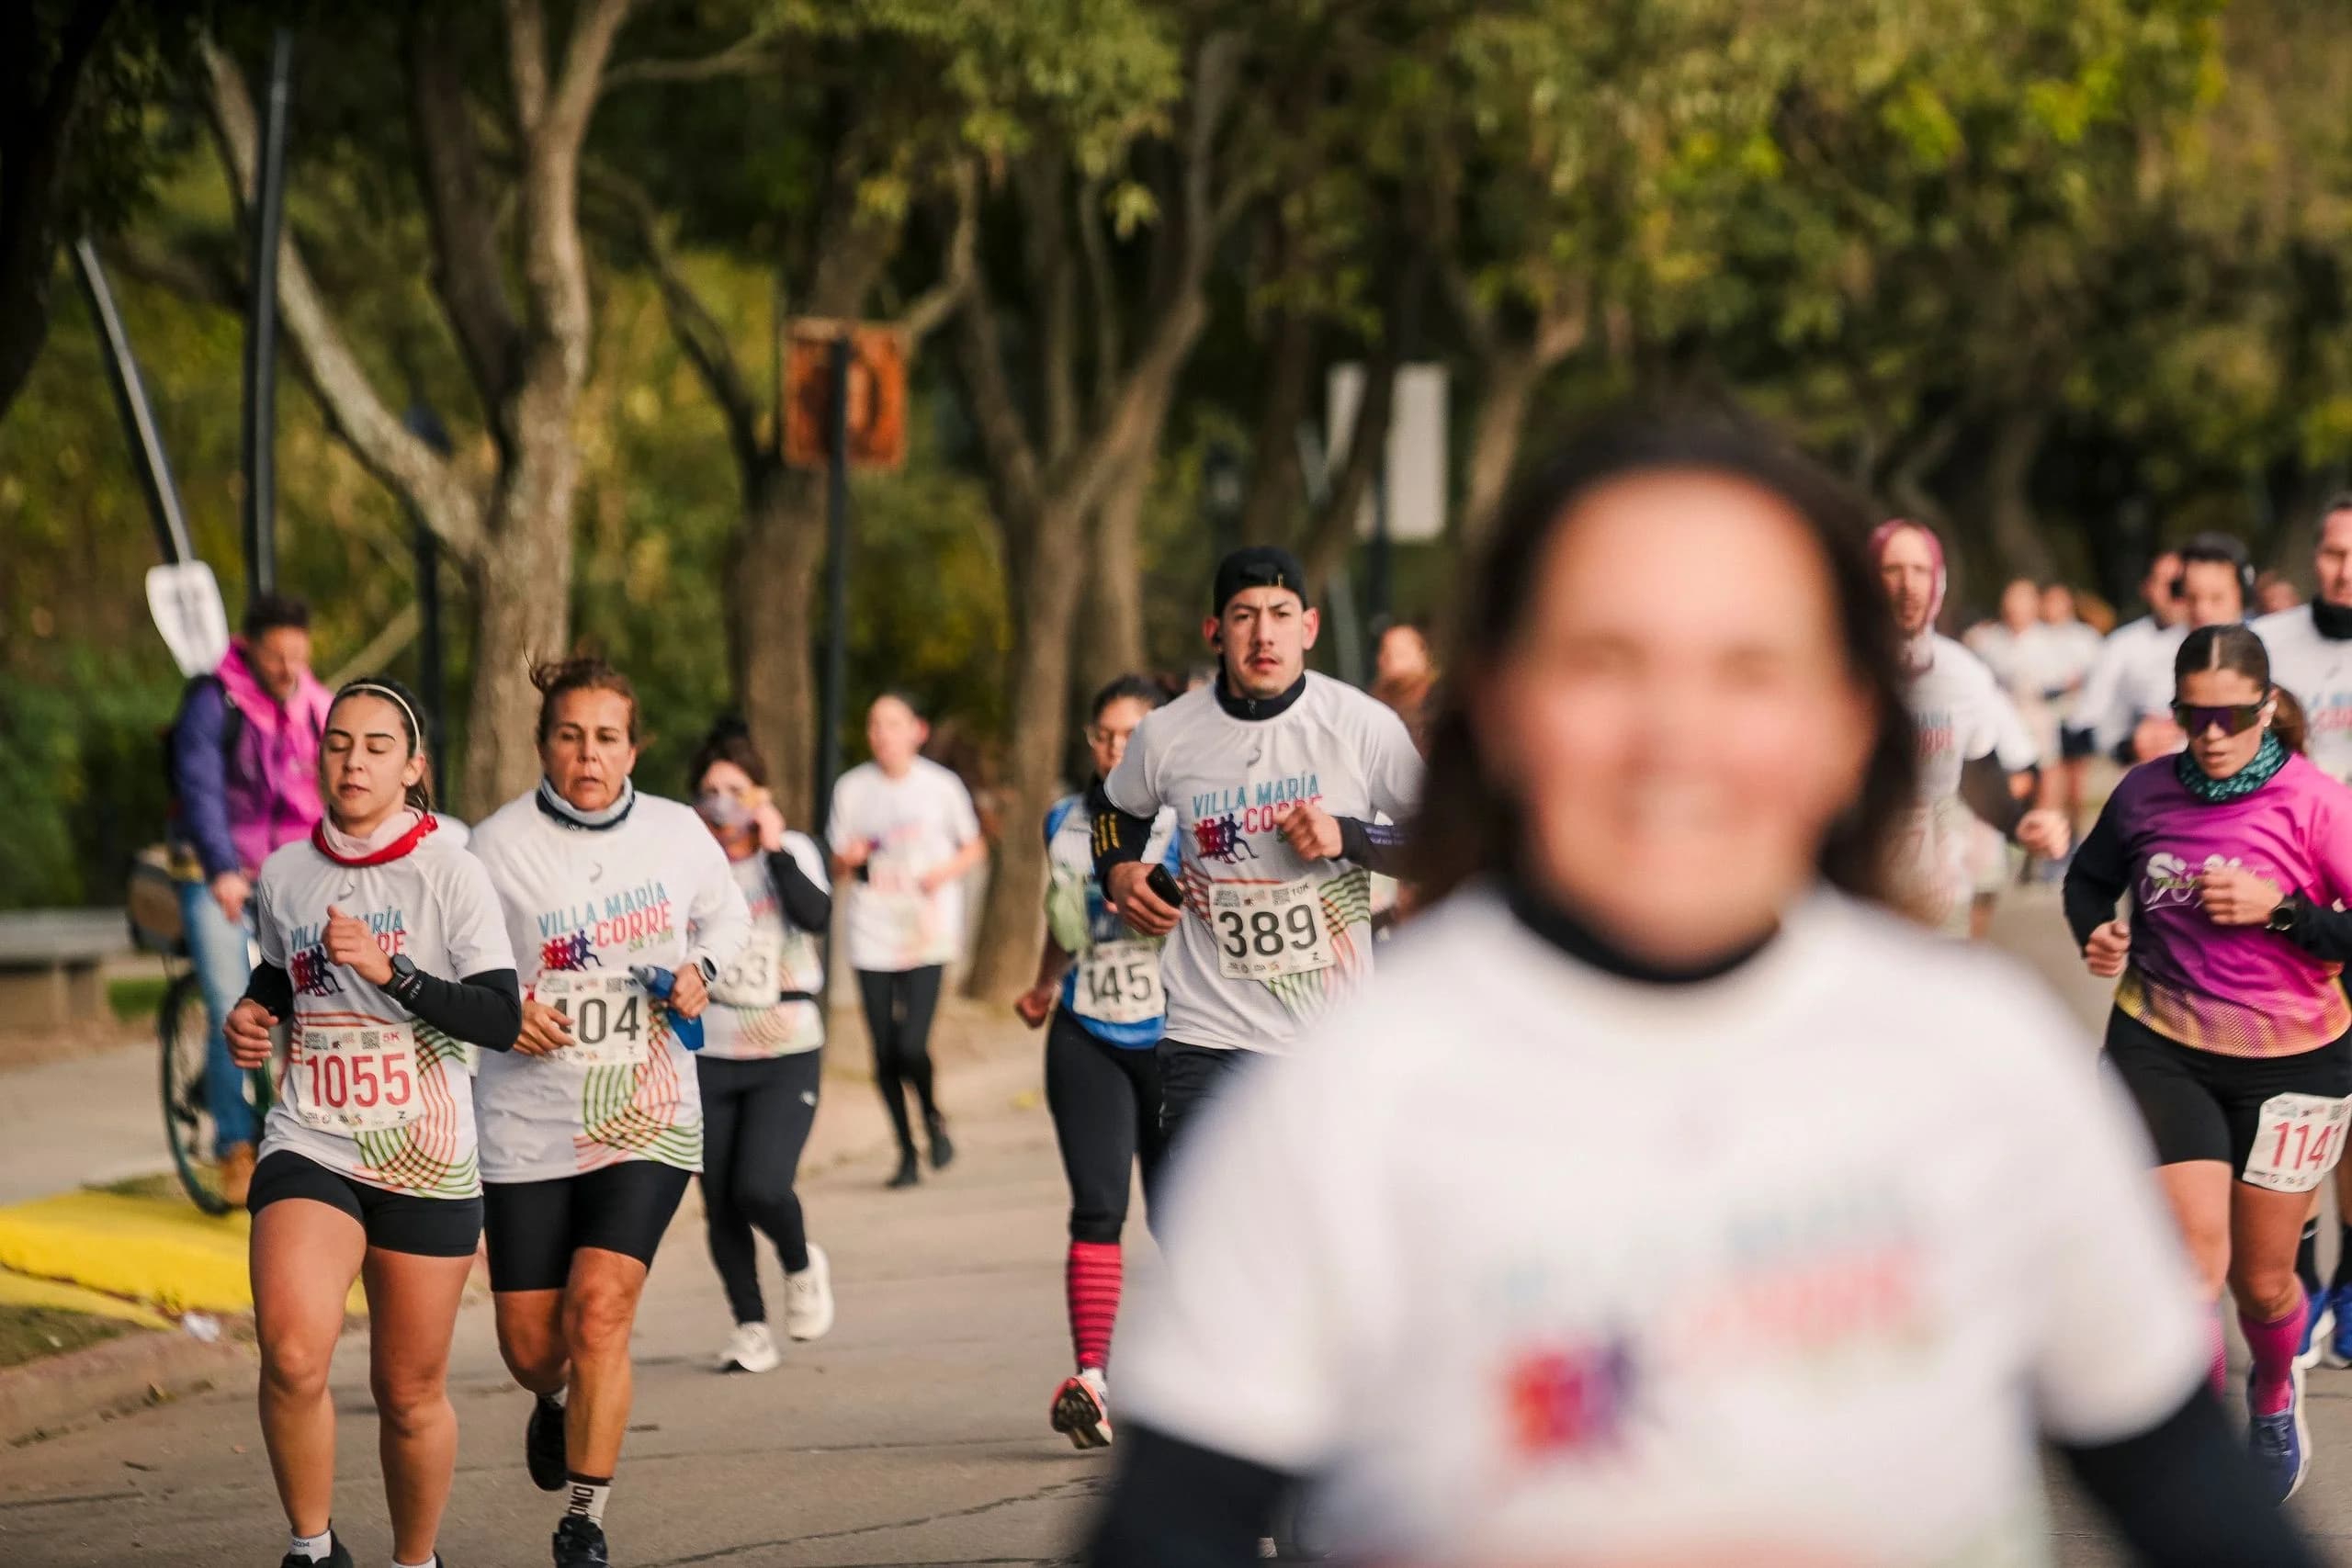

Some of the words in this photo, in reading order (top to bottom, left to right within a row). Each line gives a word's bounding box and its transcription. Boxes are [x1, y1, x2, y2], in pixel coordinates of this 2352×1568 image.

[1193, 786, 1248, 818] VILLA
[1256, 772, 1320, 807] MARÍA
[290, 922, 322, 952] VILL
[537, 901, 597, 938] VILLA
[595, 899, 672, 948] CORRE
[1219, 904, 1317, 958] 389
[1088, 963, 1151, 1007] 145
[305, 1053, 412, 1109] 1055
